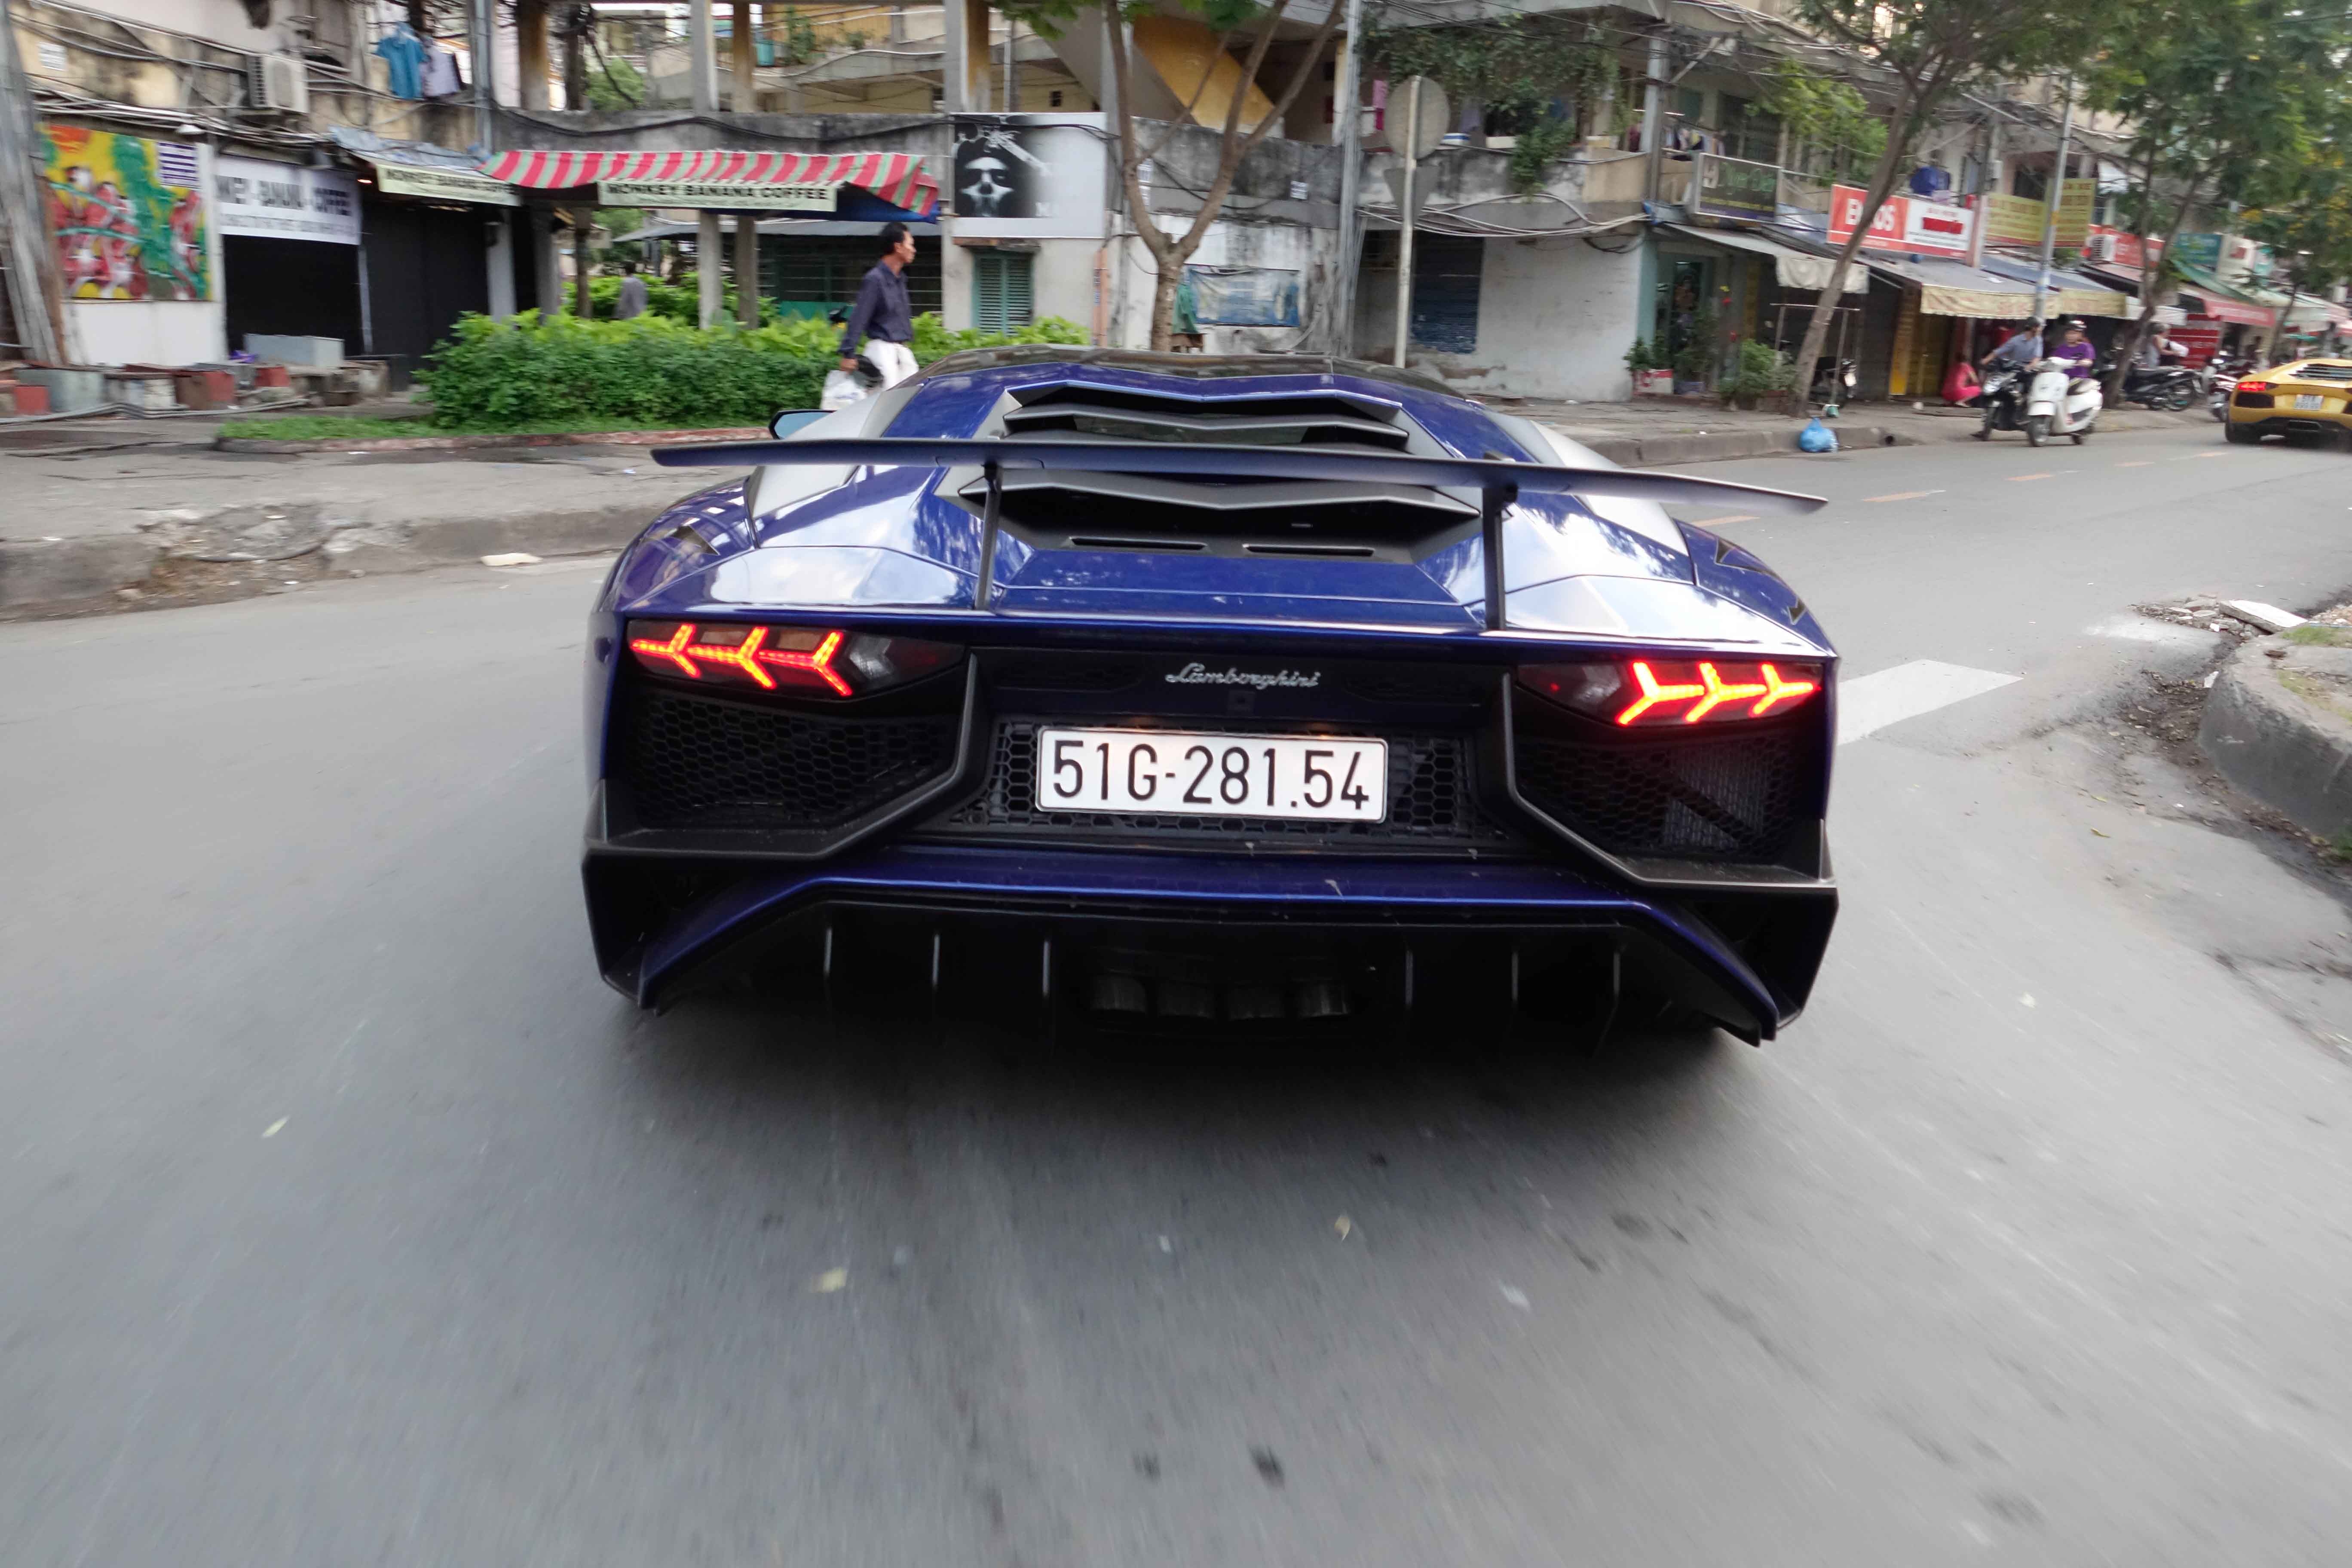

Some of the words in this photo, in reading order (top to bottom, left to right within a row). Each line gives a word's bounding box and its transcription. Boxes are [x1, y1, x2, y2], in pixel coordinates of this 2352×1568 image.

[607, 183, 678, 195] MONKEY
[686, 185, 755, 196] BANANA
[761, 187, 827, 200] COFFEE
[1165, 662, 1321, 689] Lamborghini
[1053, 740, 1370, 810] 51G-281.54
